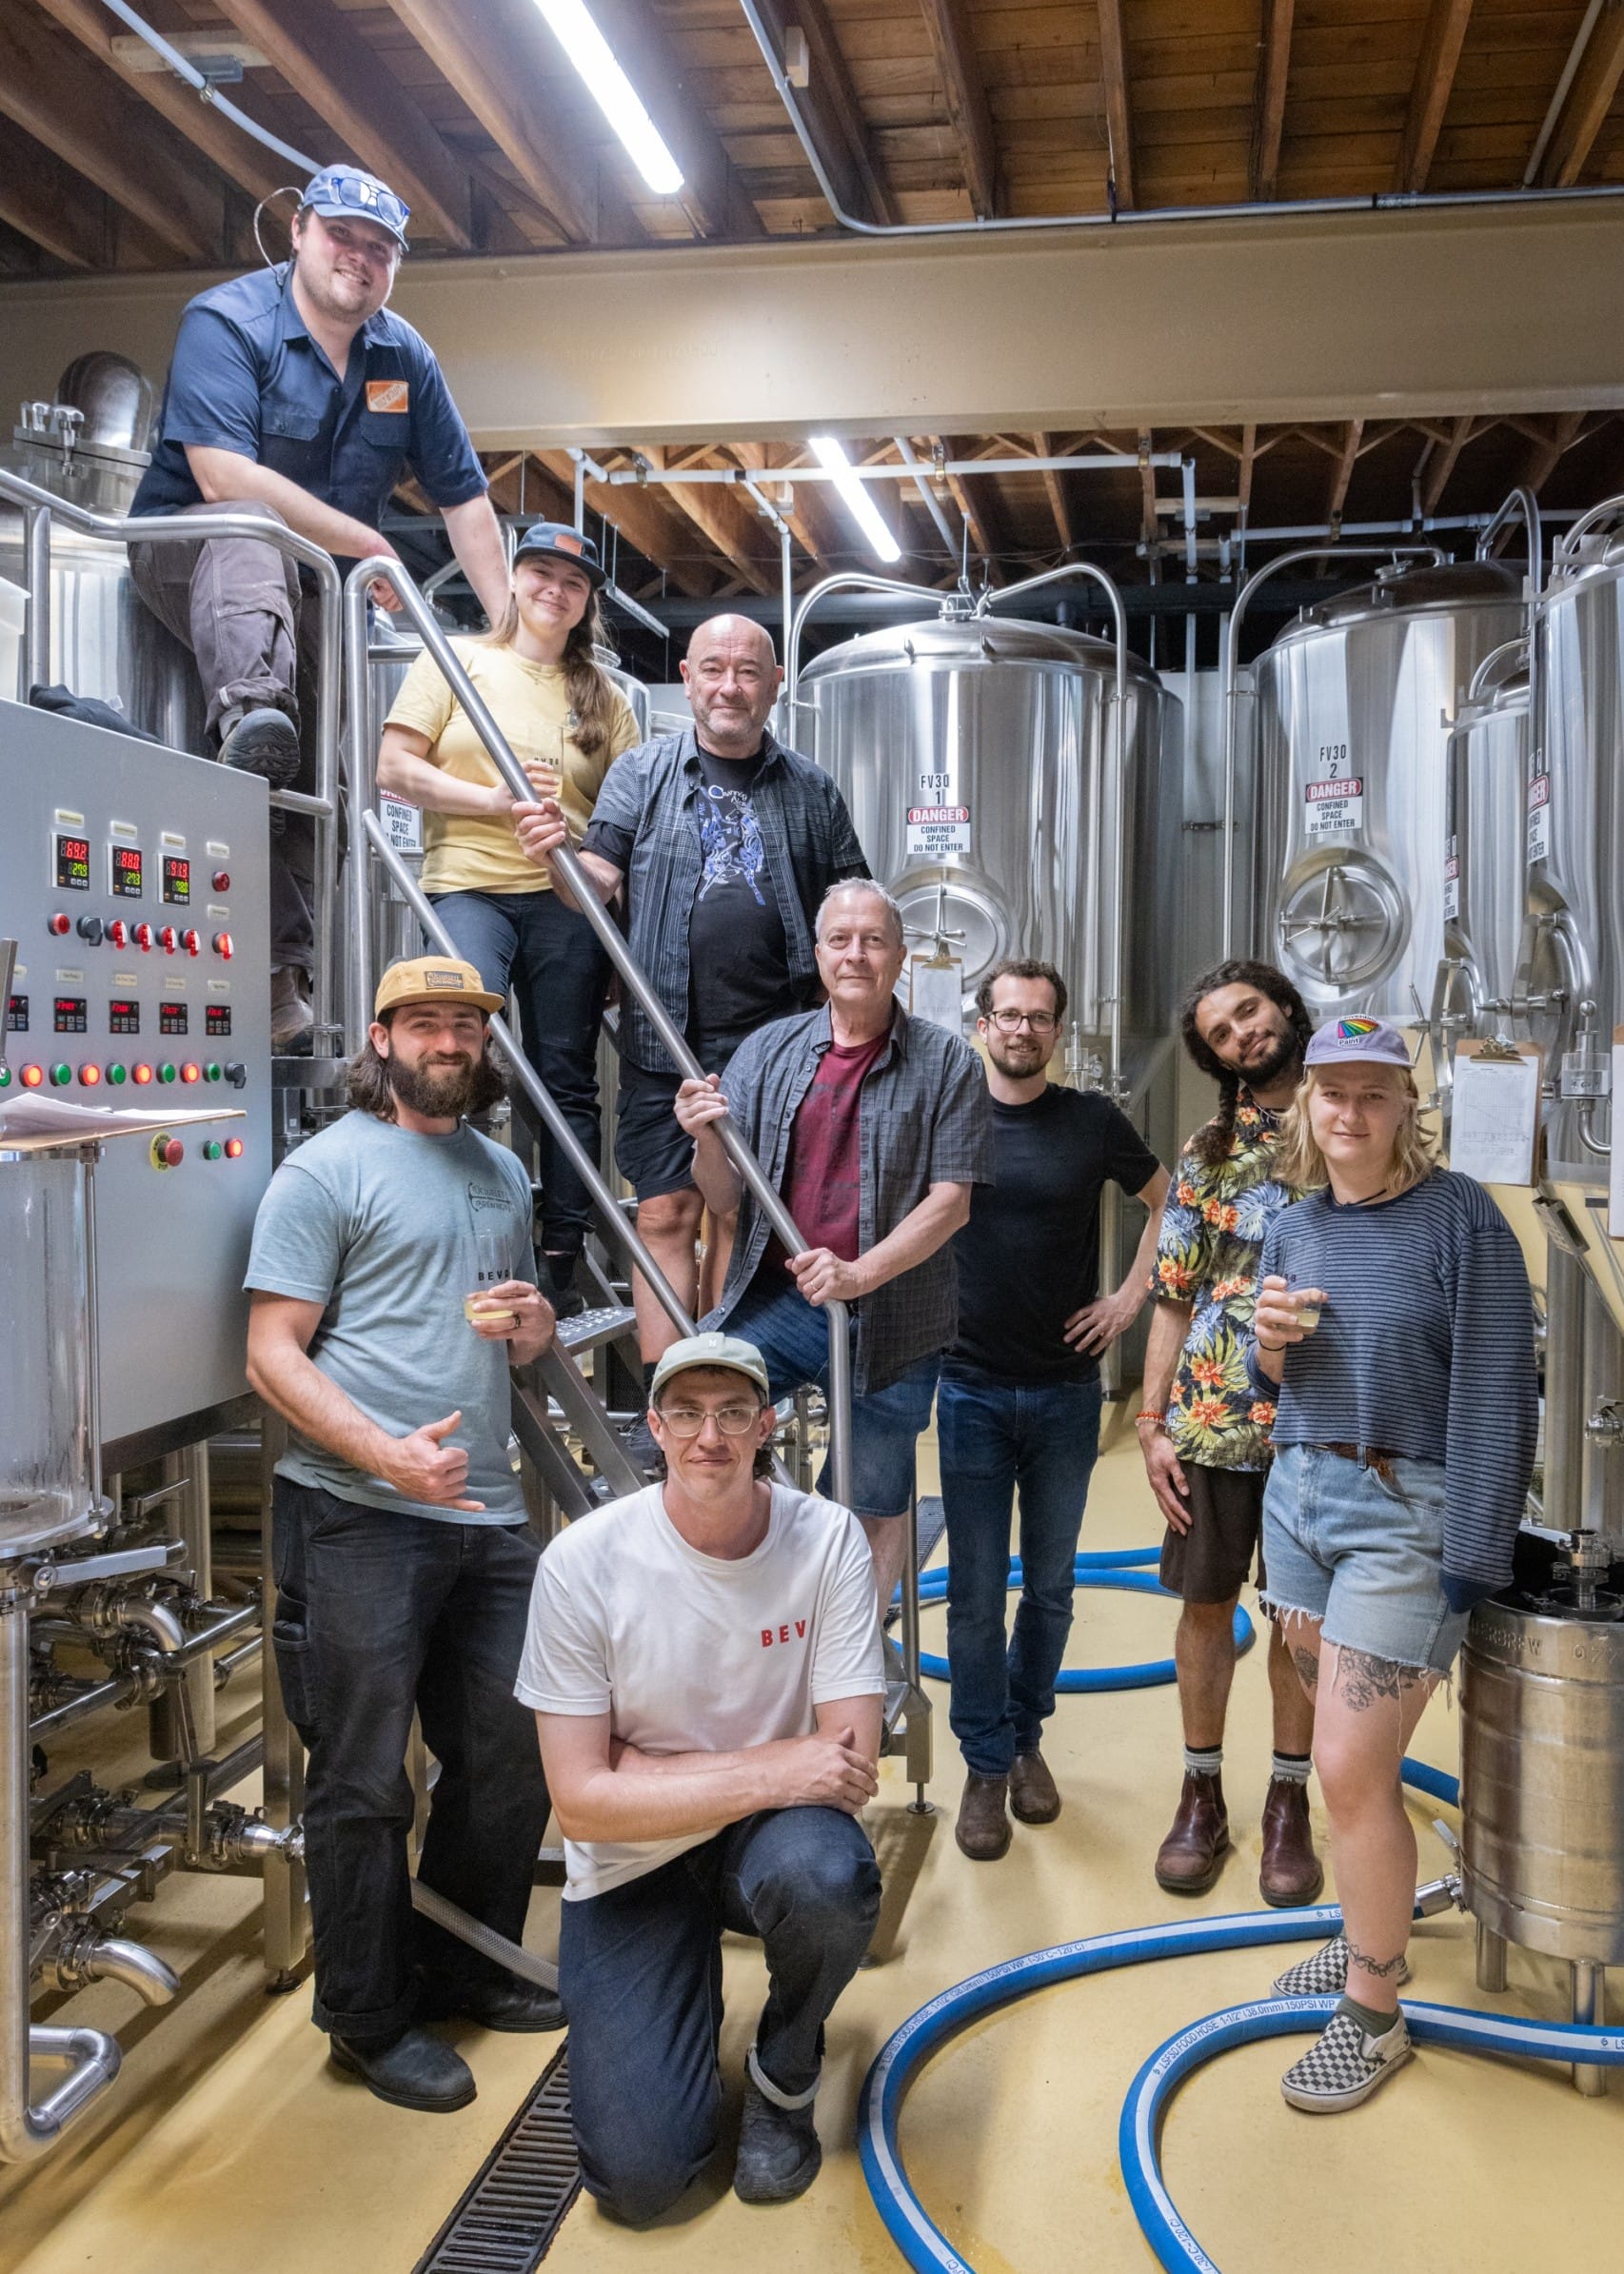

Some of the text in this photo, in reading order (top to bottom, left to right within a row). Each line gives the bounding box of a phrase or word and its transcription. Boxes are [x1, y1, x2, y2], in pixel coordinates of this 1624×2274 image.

[1319, 744, 1347, 762] FV30
[1329, 762, 1337, 779] 2
[921, 774, 949, 789] FV30
[935, 791, 941, 804] 1
[1310, 781, 1357, 800] DANGER
[386, 804, 412, 821] CONFINED
[1317, 800, 1349, 812] CONFINED
[912, 808, 964, 822] DANGER
[1321, 810, 1342, 821] SPACE
[391, 820, 409, 836] SPACE
[921, 825, 956, 834] CONFINED
[1310, 819, 1356, 832] DO NOT ENTER
[390, 834, 416, 848] NOT ENTER
[926, 834, 950, 843] SPACE
[925, 843, 939, 852] NOT
[941, 842, 963, 851] ENTER
[761, 1619, 806, 1648] BEV
[895, 2024, 915, 2044] FOOD
[913, 2008, 934, 2027] HOSE
[986, 1966, 1010, 1981] 150PSI
[1159, 2046, 1179, 2068] LSFSD
[1176, 2032, 1198, 2051] FOOD
[1195, 2020, 1219, 2038] HOSE
[1286, 2000, 1317, 2010] 150PSI
